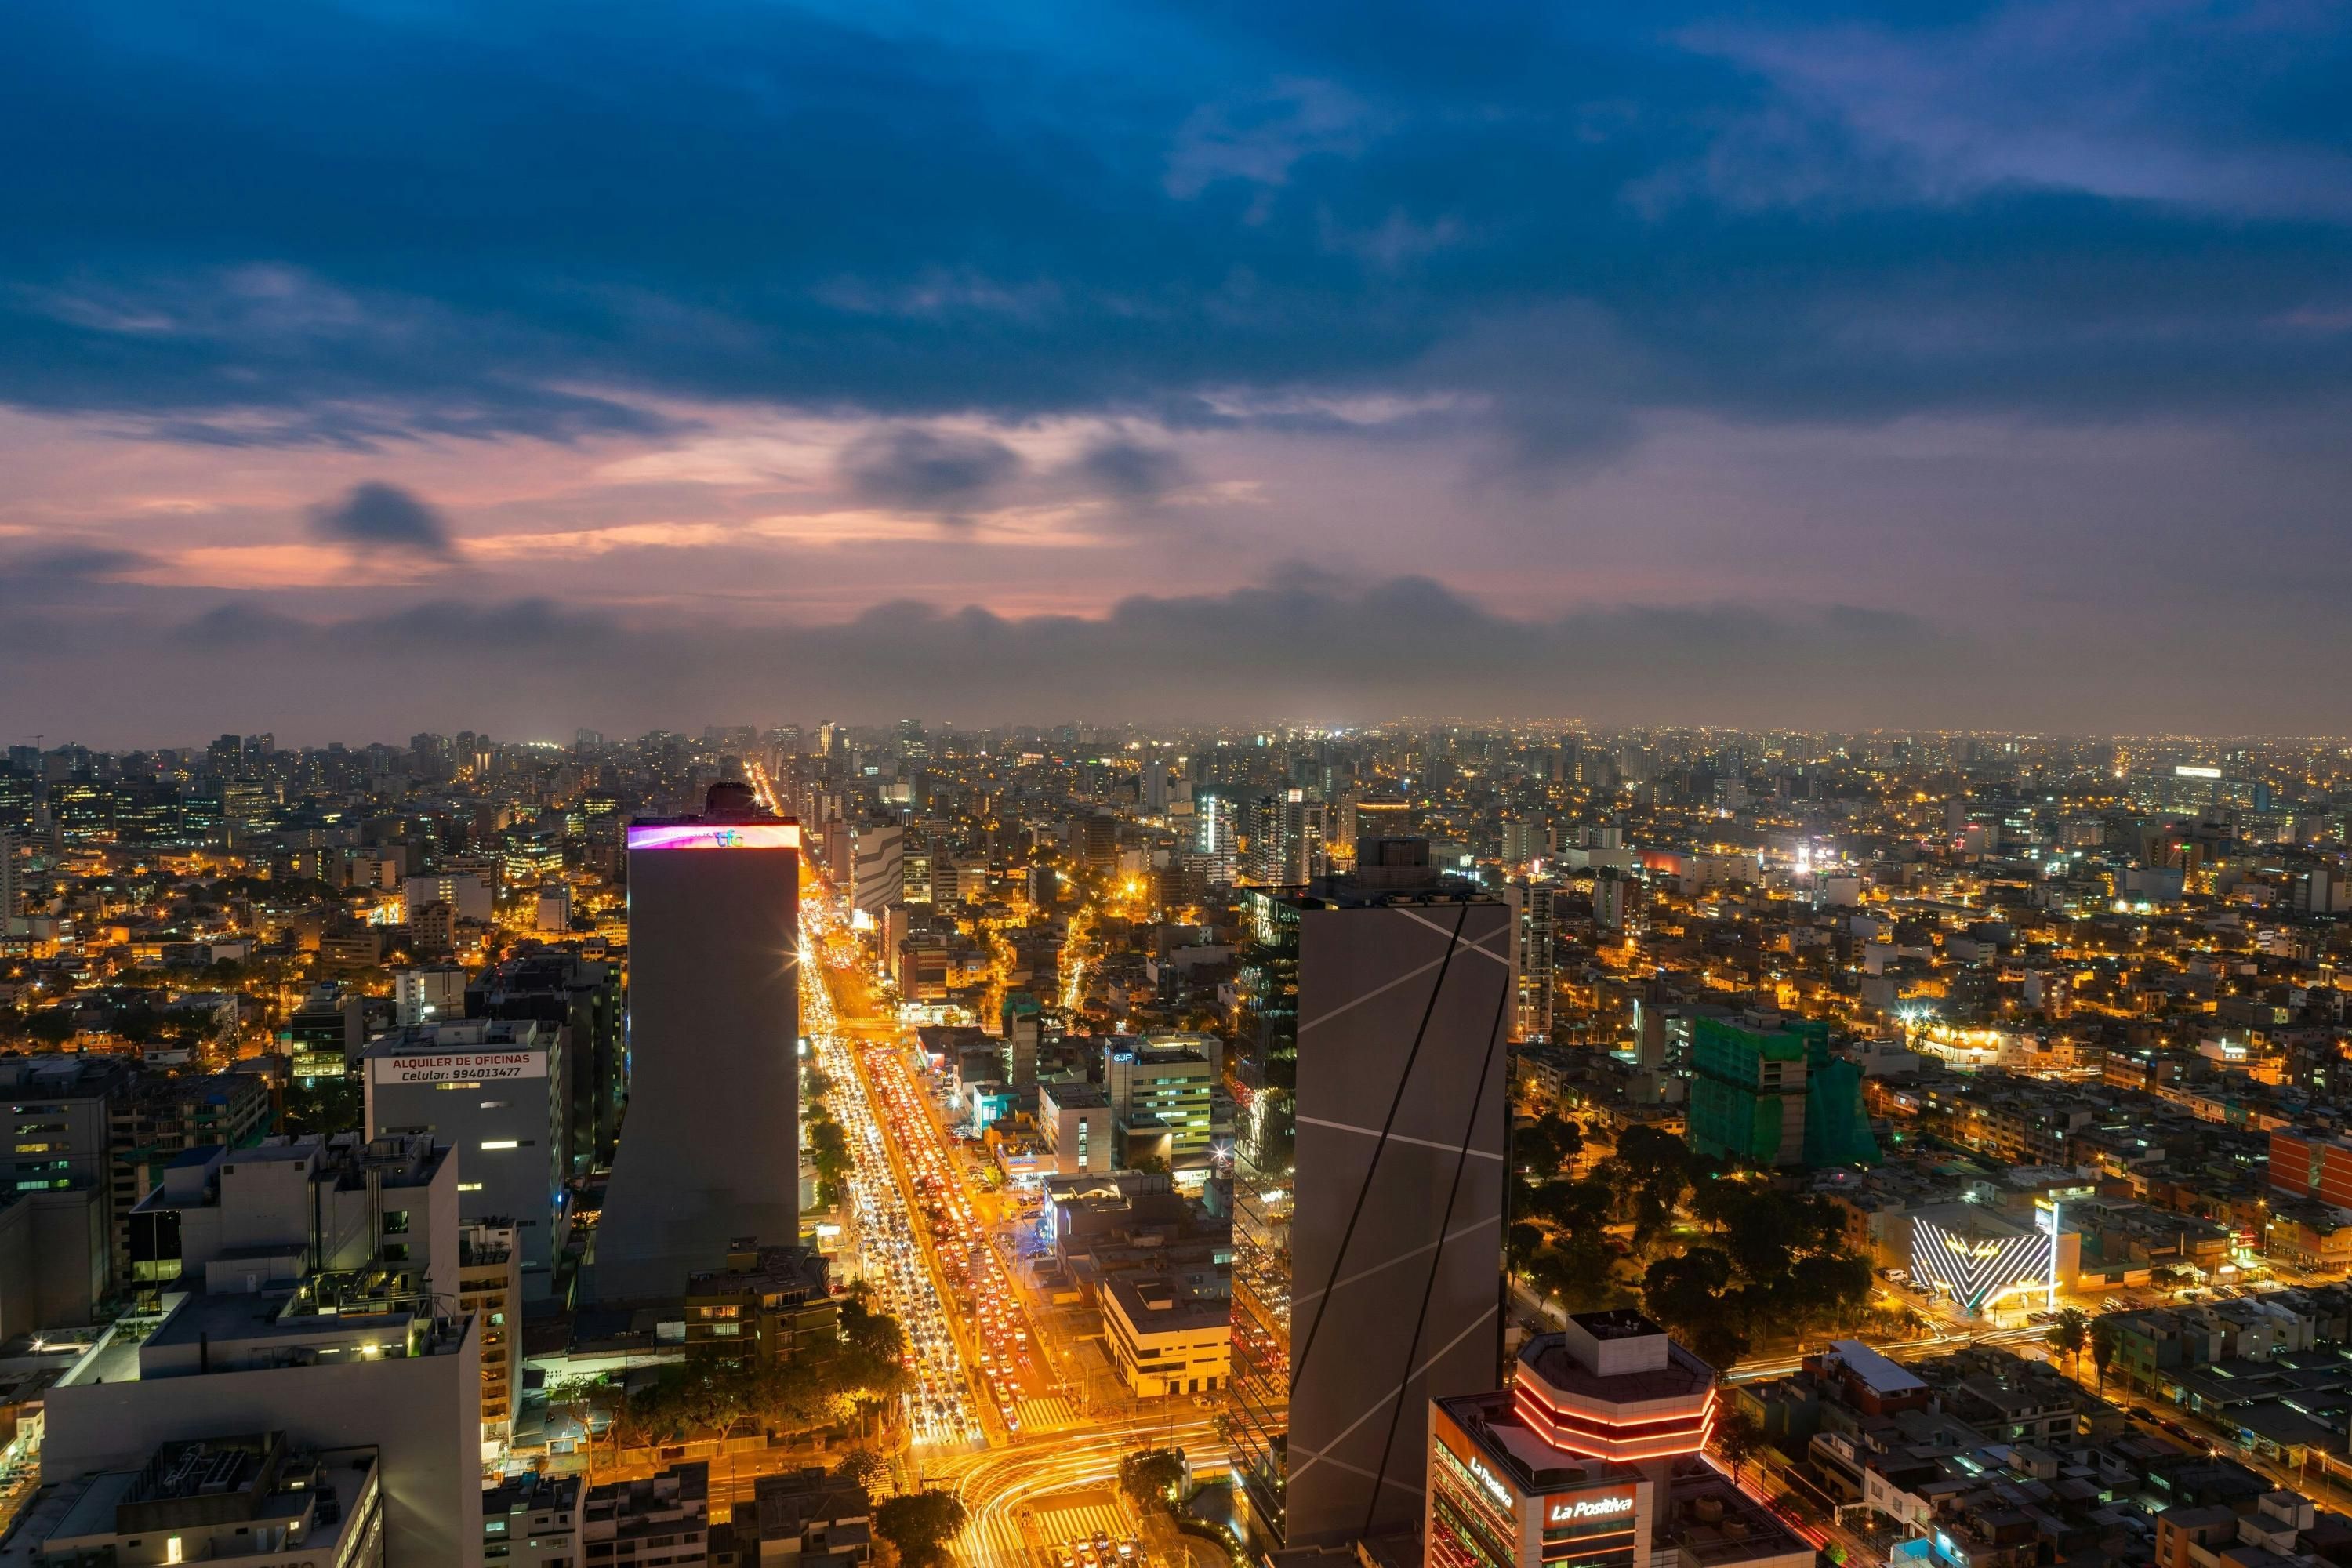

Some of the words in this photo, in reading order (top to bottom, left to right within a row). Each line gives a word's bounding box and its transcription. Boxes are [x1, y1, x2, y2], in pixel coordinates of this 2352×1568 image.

[393, 1058, 452, 1069] ALQUILER
[456, 1057, 471, 1065] DE
[475, 1054, 530, 1065] OFICINAS
[402, 1070, 449, 1081] Celular:
[453, 1068, 520, 1079] 994013477
[1471, 1457, 1482, 1475] La
[1481, 1467, 1512, 1508] Positiva
[1552, 1505, 1573, 1520] La
[1573, 1497, 1632, 1518] Positiva
